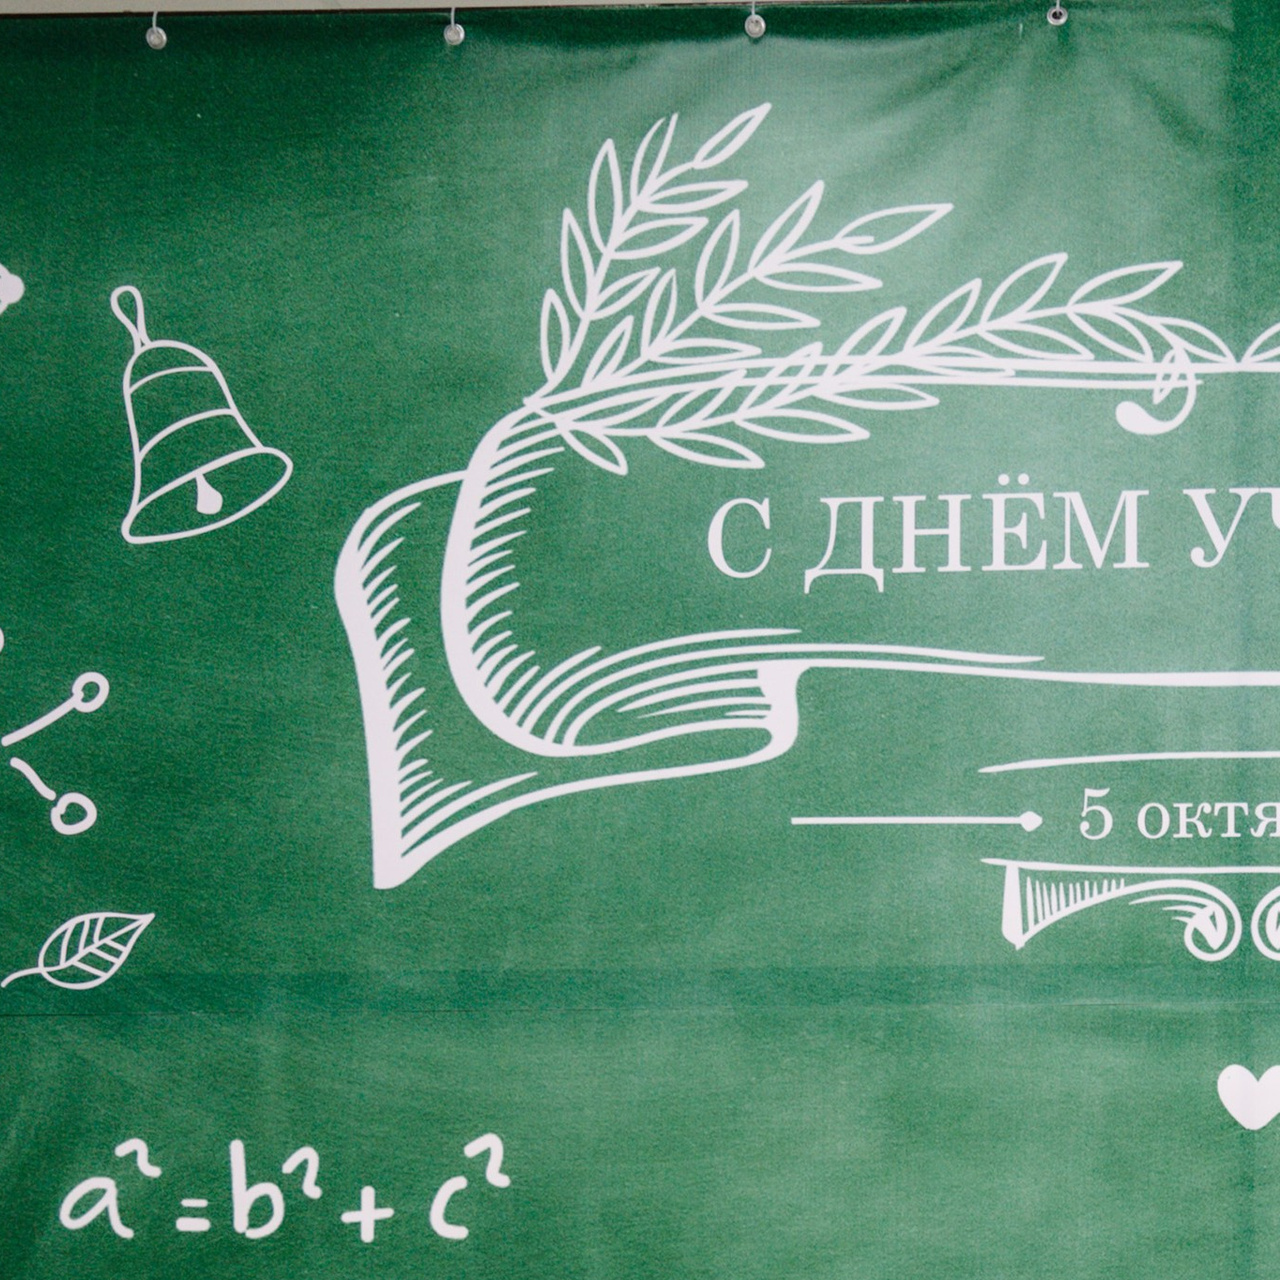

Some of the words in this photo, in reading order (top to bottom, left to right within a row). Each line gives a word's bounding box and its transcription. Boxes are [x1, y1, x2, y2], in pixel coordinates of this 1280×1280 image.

[707, 498, 772, 578] С
[804, 473, 1150, 594] ДНЁМ
[1079, 788, 1113, 840] 5
